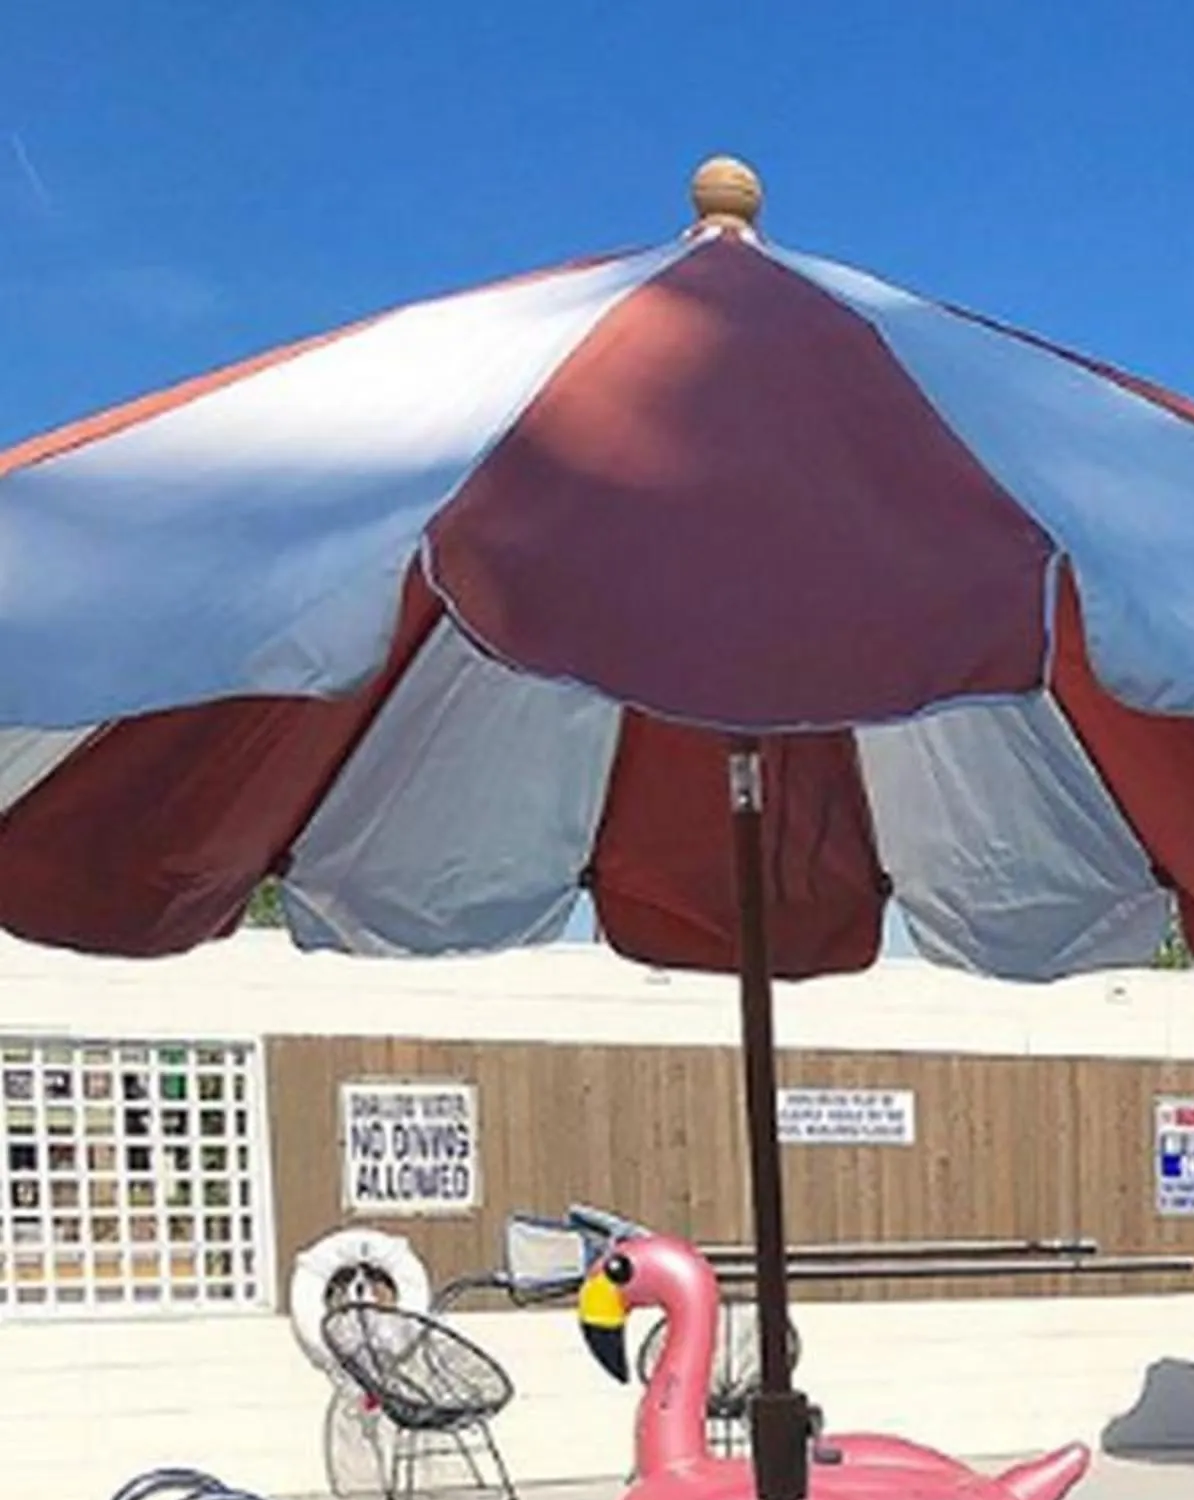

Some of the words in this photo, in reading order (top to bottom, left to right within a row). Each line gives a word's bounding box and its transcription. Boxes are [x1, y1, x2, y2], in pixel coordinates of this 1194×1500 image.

[351, 1122, 386, 1160] NO
[393, 1122, 469, 1160] DIVING
[357, 1163, 469, 1200] ALLOWED
